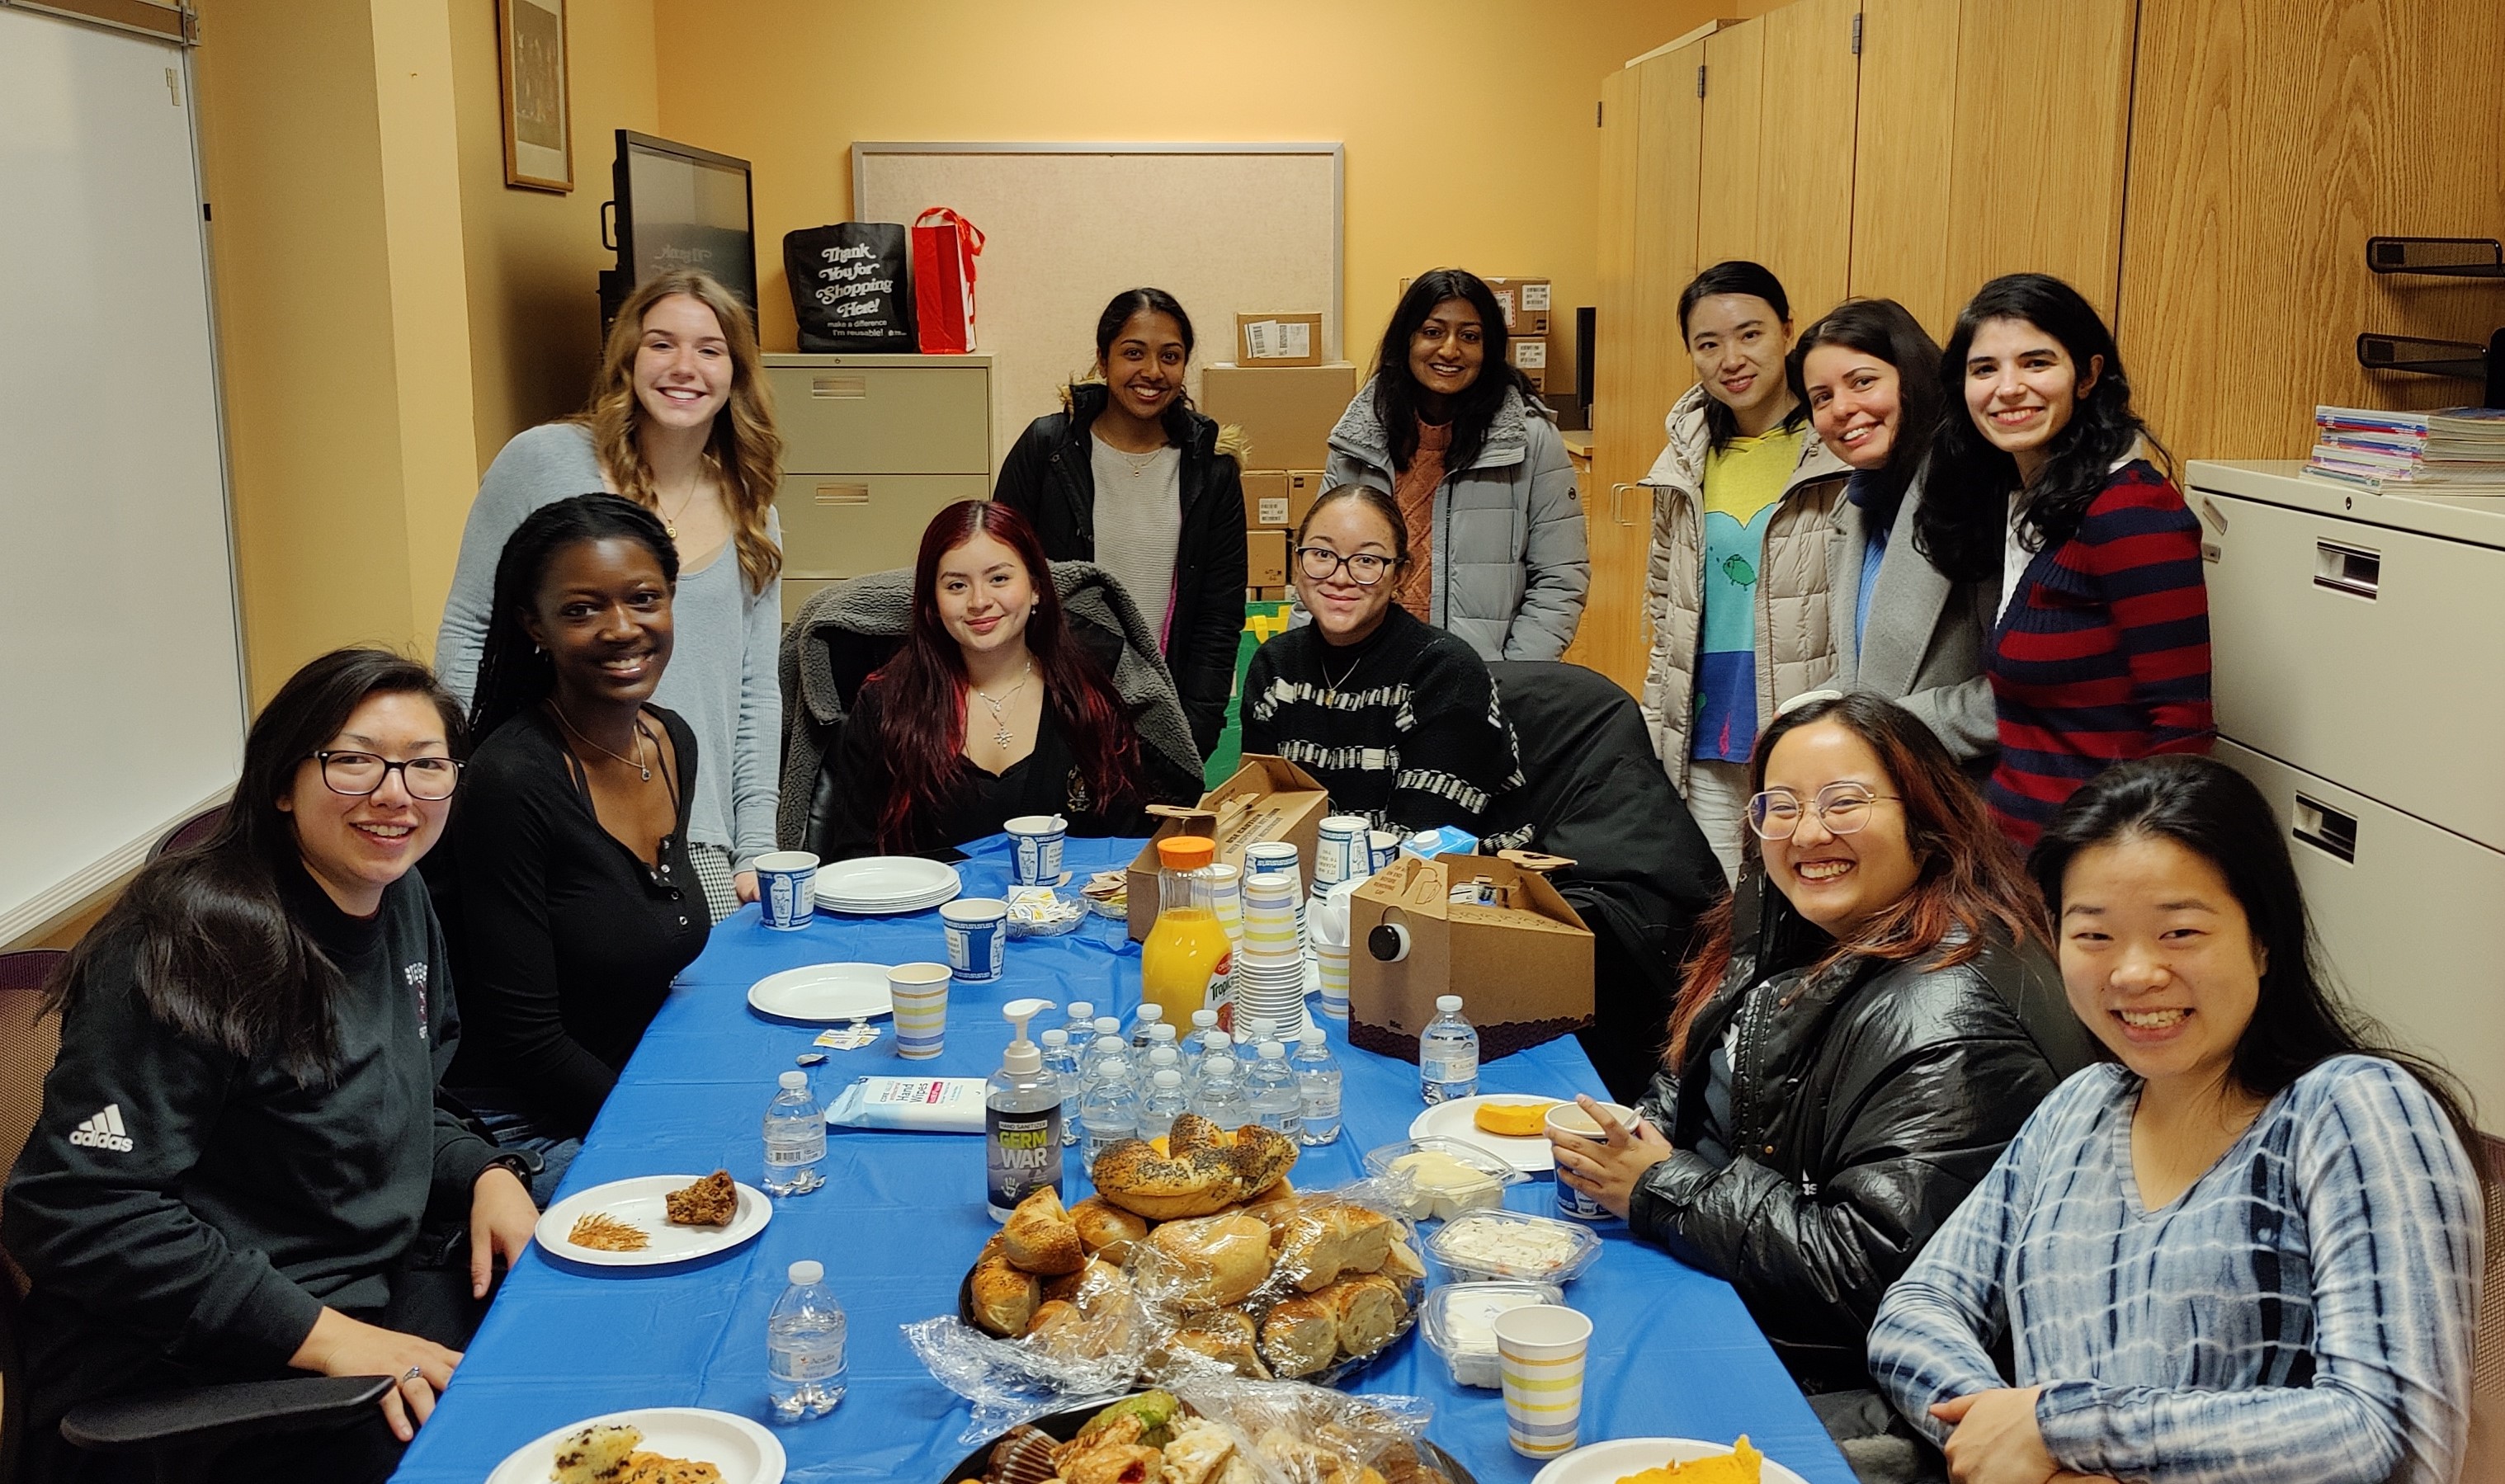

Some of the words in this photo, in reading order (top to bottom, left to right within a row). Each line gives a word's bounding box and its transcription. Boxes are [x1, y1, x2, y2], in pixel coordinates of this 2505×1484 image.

[821, 243, 876, 263] Thank
[818, 266, 852, 281] You
[847, 262, 880, 280] for
[815, 278, 894, 304] Shopping
[837, 298, 880, 318] Here!
[847, 328, 884, 337] reusable!
[854, 319, 887, 327] difference
[1225, 833, 1240, 843] USE
[1237, 813, 1263, 834] CAUTION
[896, 1083, 914, 1101] Hand
[909, 1082, 928, 1104] Wipes
[69, 1131, 134, 1152] adidas
[999, 1130, 1047, 1149] GERM
[1001, 1147, 1048, 1169] WAR
